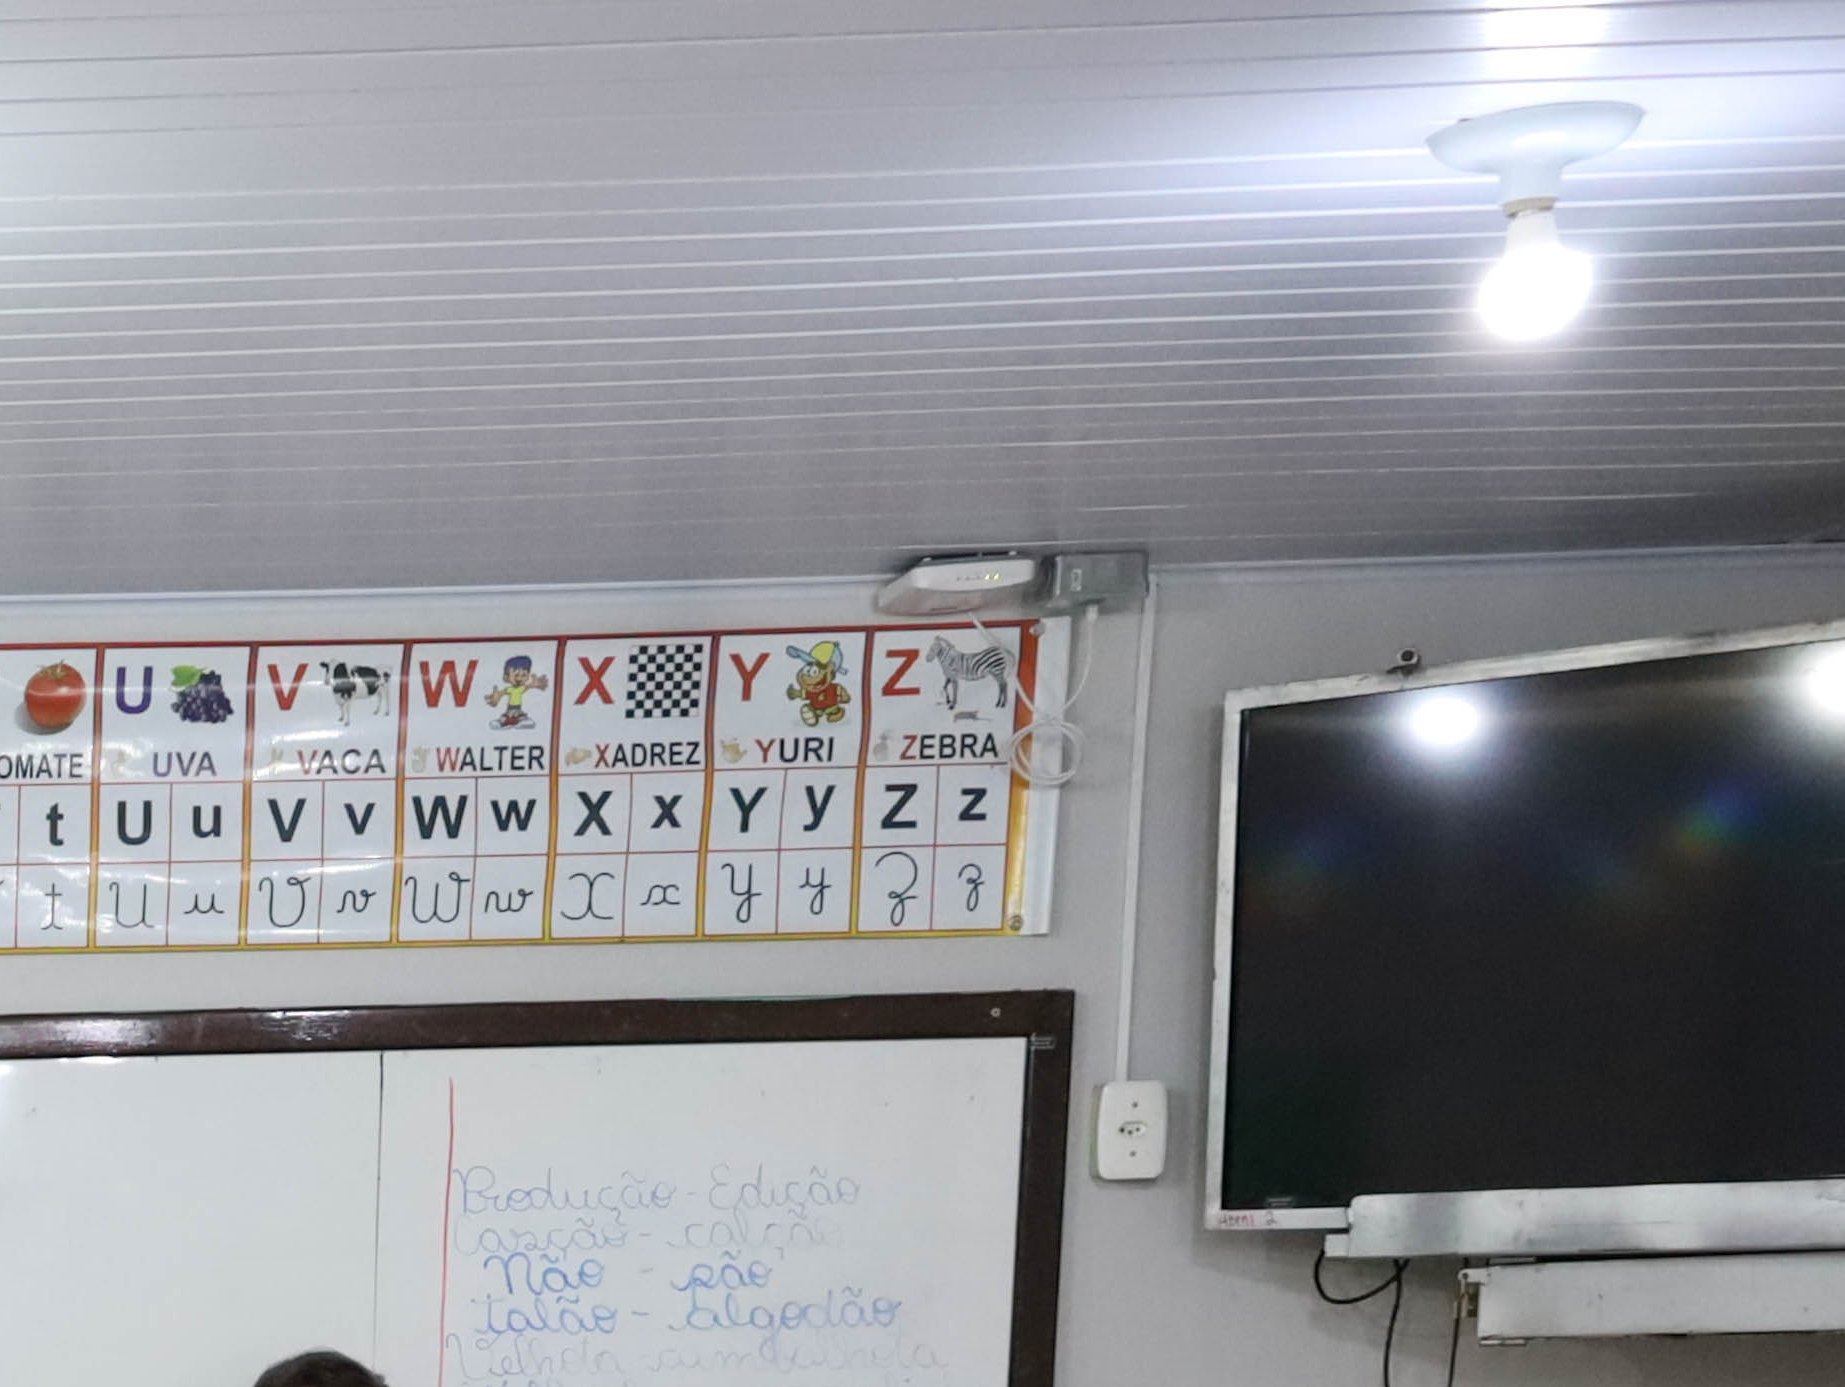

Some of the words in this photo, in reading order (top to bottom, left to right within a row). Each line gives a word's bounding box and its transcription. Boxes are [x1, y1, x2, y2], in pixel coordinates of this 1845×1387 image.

[298, 747, 386, 775] VACA
[435, 744, 545, 773] WALTER
[593, 740, 701, 770] XADREZ
[755, 736, 835, 766] YURI
[899, 733, 1000, 762] ZEBRA
[151, 749, 216, 777] UVA
